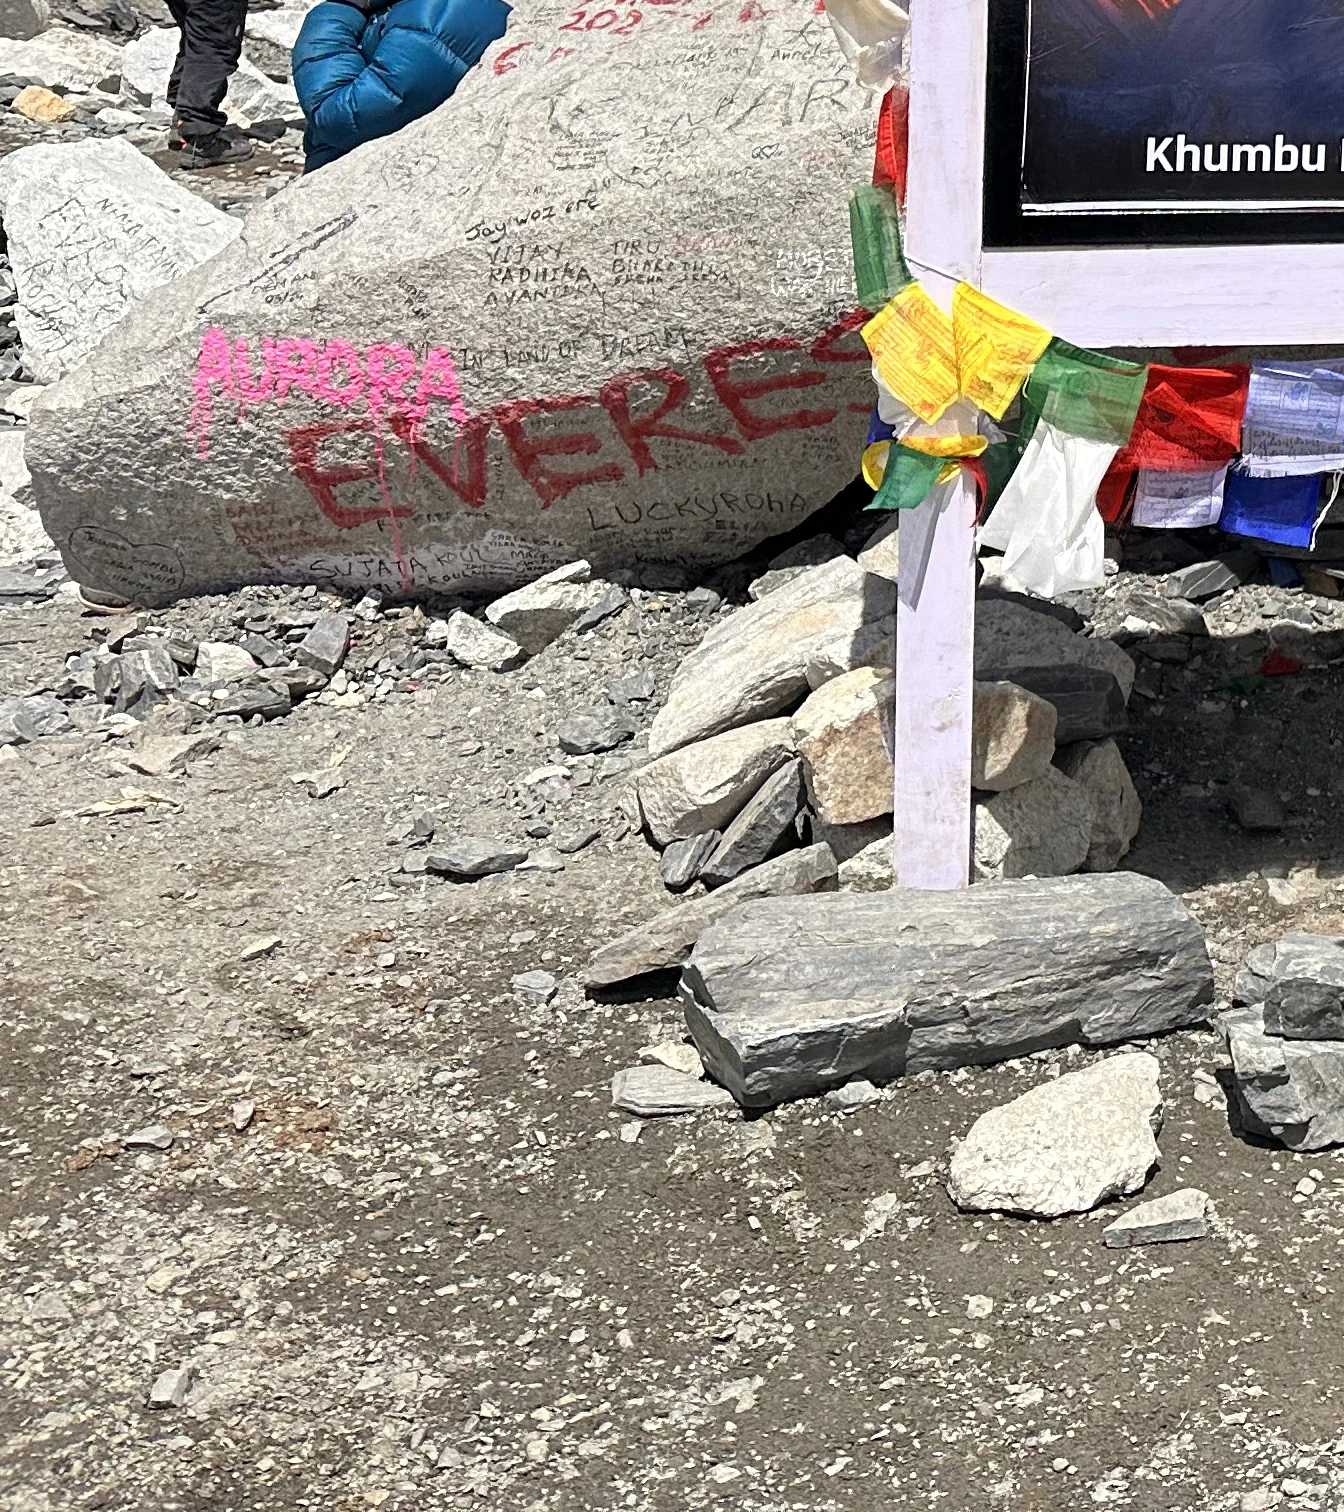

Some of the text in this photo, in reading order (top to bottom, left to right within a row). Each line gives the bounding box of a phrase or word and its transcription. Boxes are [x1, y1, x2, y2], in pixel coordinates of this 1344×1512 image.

[1145, 134, 1326, 172] Khumbu
[192, 325, 469, 424] AURORA
[309, 557, 428, 579] SUJATA
